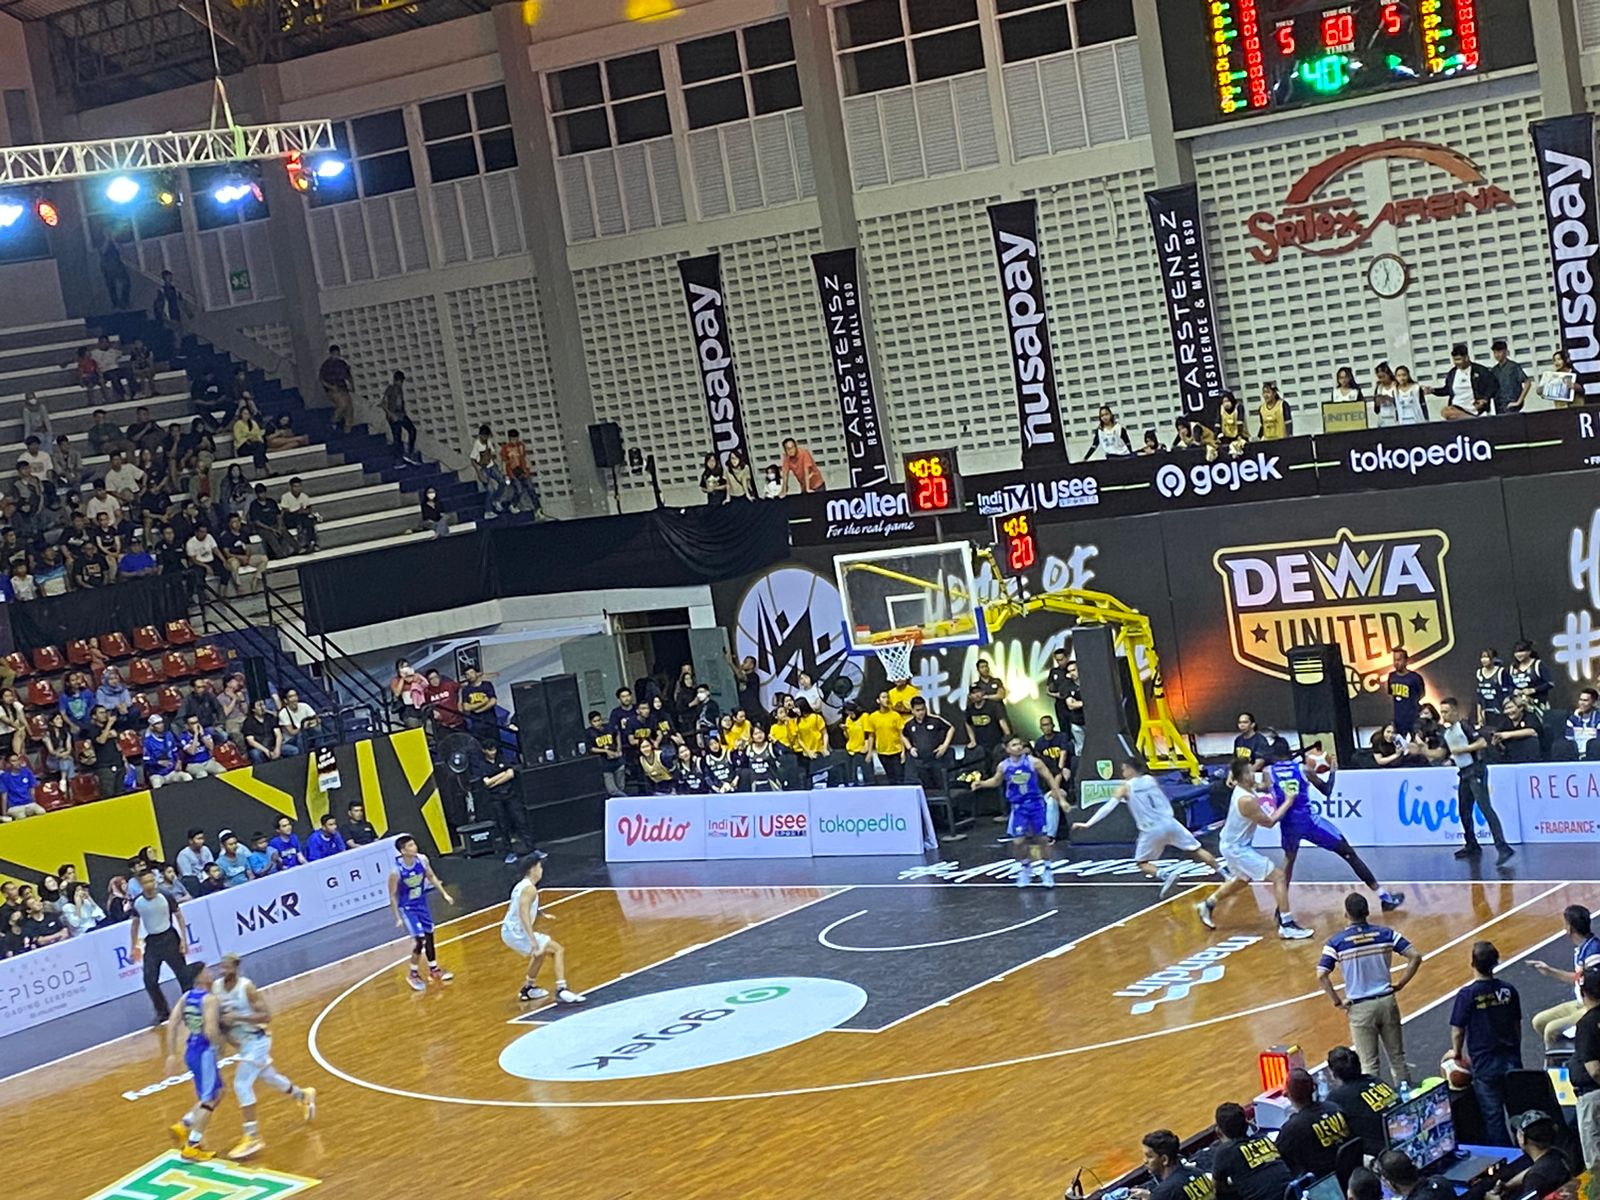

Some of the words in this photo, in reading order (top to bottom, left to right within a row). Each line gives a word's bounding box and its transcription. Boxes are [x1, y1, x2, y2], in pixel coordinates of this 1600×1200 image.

[1324, 14, 1354, 46] 60
[1384, 5, 1401, 33] 5
[1280, 27, 1296, 54] 5
[1366, 185, 1516, 232] ARENA
[1182, 218, 1197, 246] BSD
[1187, 251, 1203, 291] MALL
[1160, 210, 1205, 413] CARSTENSZ
[999, 230, 1056, 449] nusapay
[1196, 316, 1220, 398] RESIDENCE
[824, 274, 865, 458] CARSTENSZ
[857, 371, 879, 447] RESIDENCE
[1189, 452, 1284, 496] gojek
[1349, 434, 1493, 475] tokopedia
[918, 477, 949, 510] 20
[826, 524, 843, 539] For
[843, 520, 861, 536] the
[861, 518, 884, 534] real
[883, 520, 916, 537] game
[1011, 535, 1035, 569] 20
[1224, 540, 1436, 608] DEWA
[617, 813, 691, 847] Vidio
[819, 812, 907, 838] tokopedia
[236, 891, 301, 936] NKR
[566, 1007, 735, 1071] gojek
